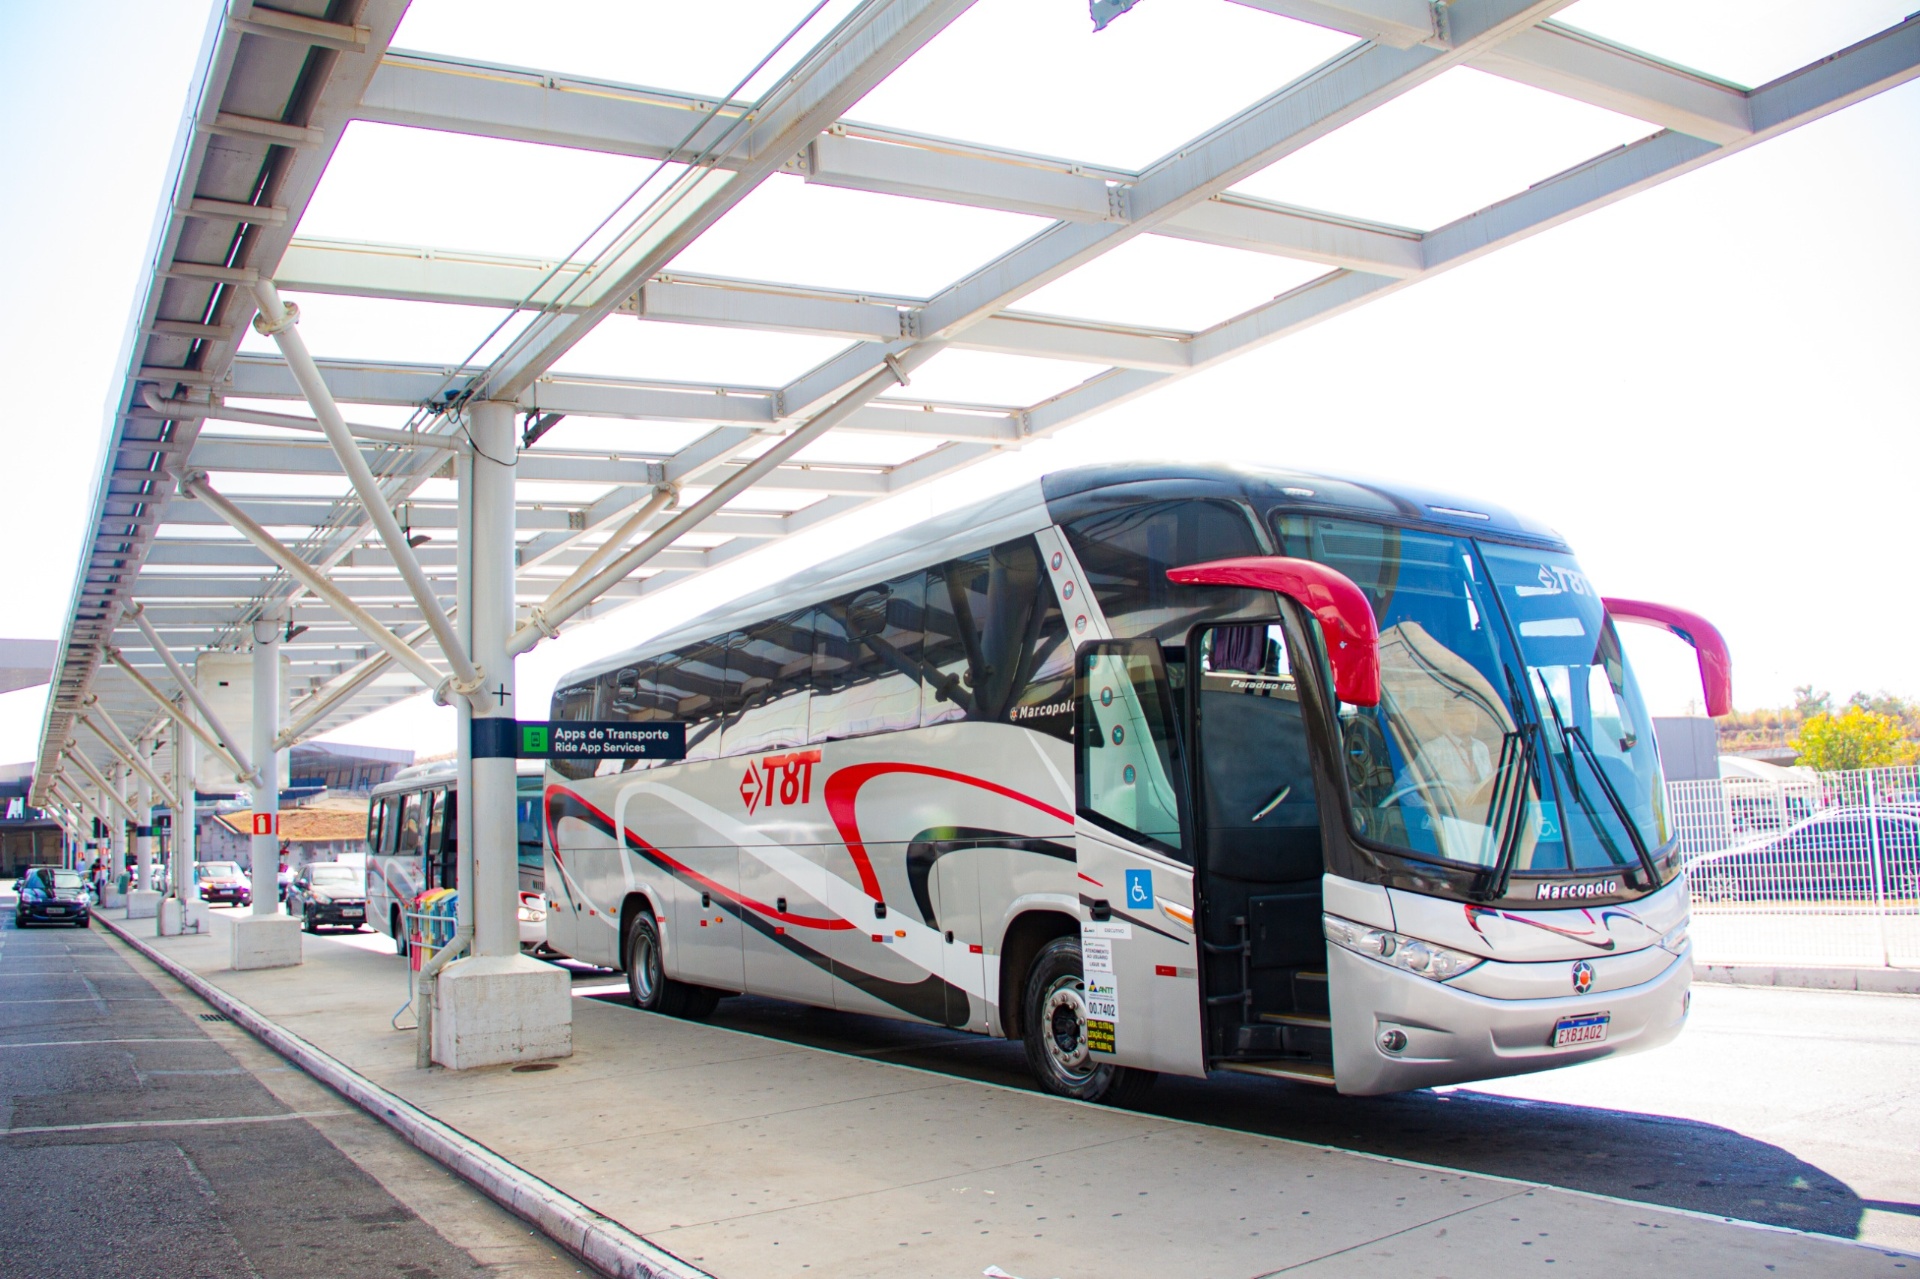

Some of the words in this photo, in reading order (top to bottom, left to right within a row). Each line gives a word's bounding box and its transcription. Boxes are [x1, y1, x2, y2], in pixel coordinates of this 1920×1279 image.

[1230, 680, 1279, 690] Paradiso
[555, 728, 586, 741] Apps
[588, 728, 604, 740] de
[606, 728, 669, 742] Transporte
[555, 742, 578, 752] Ride
[579, 742, 601, 754] App
[603, 742, 646, 752] Services
[762, 749, 822, 807] T8T
[1537, 880, 1617, 900] Marcopolo
[1098, 986, 1114, 994] ANTT
[1088, 1001, 1116, 1017] 00.7402
[1558, 1025, 1603, 1044] EXB1A02
